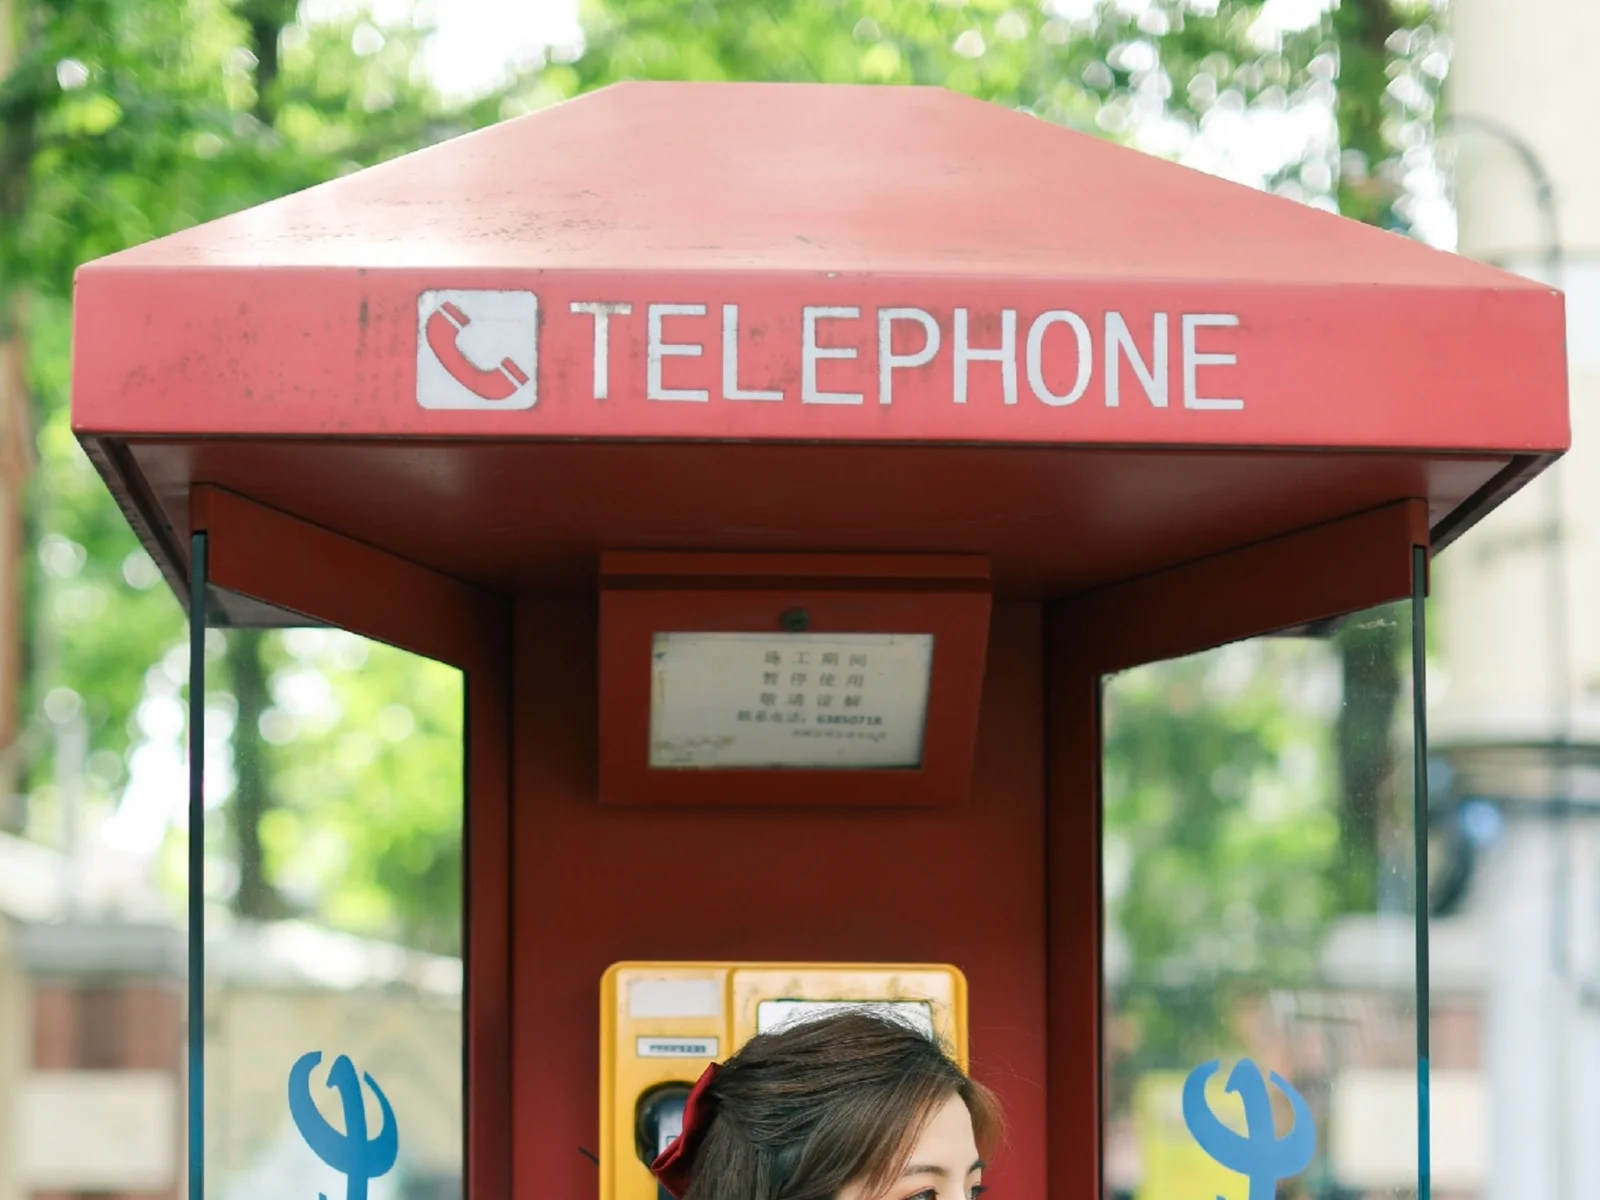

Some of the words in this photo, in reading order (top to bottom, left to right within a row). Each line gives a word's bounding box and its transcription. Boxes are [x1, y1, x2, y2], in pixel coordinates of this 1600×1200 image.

[570, 301, 1244, 411] TELEPHONE
[762, 671, 865, 689] 暂停使用
